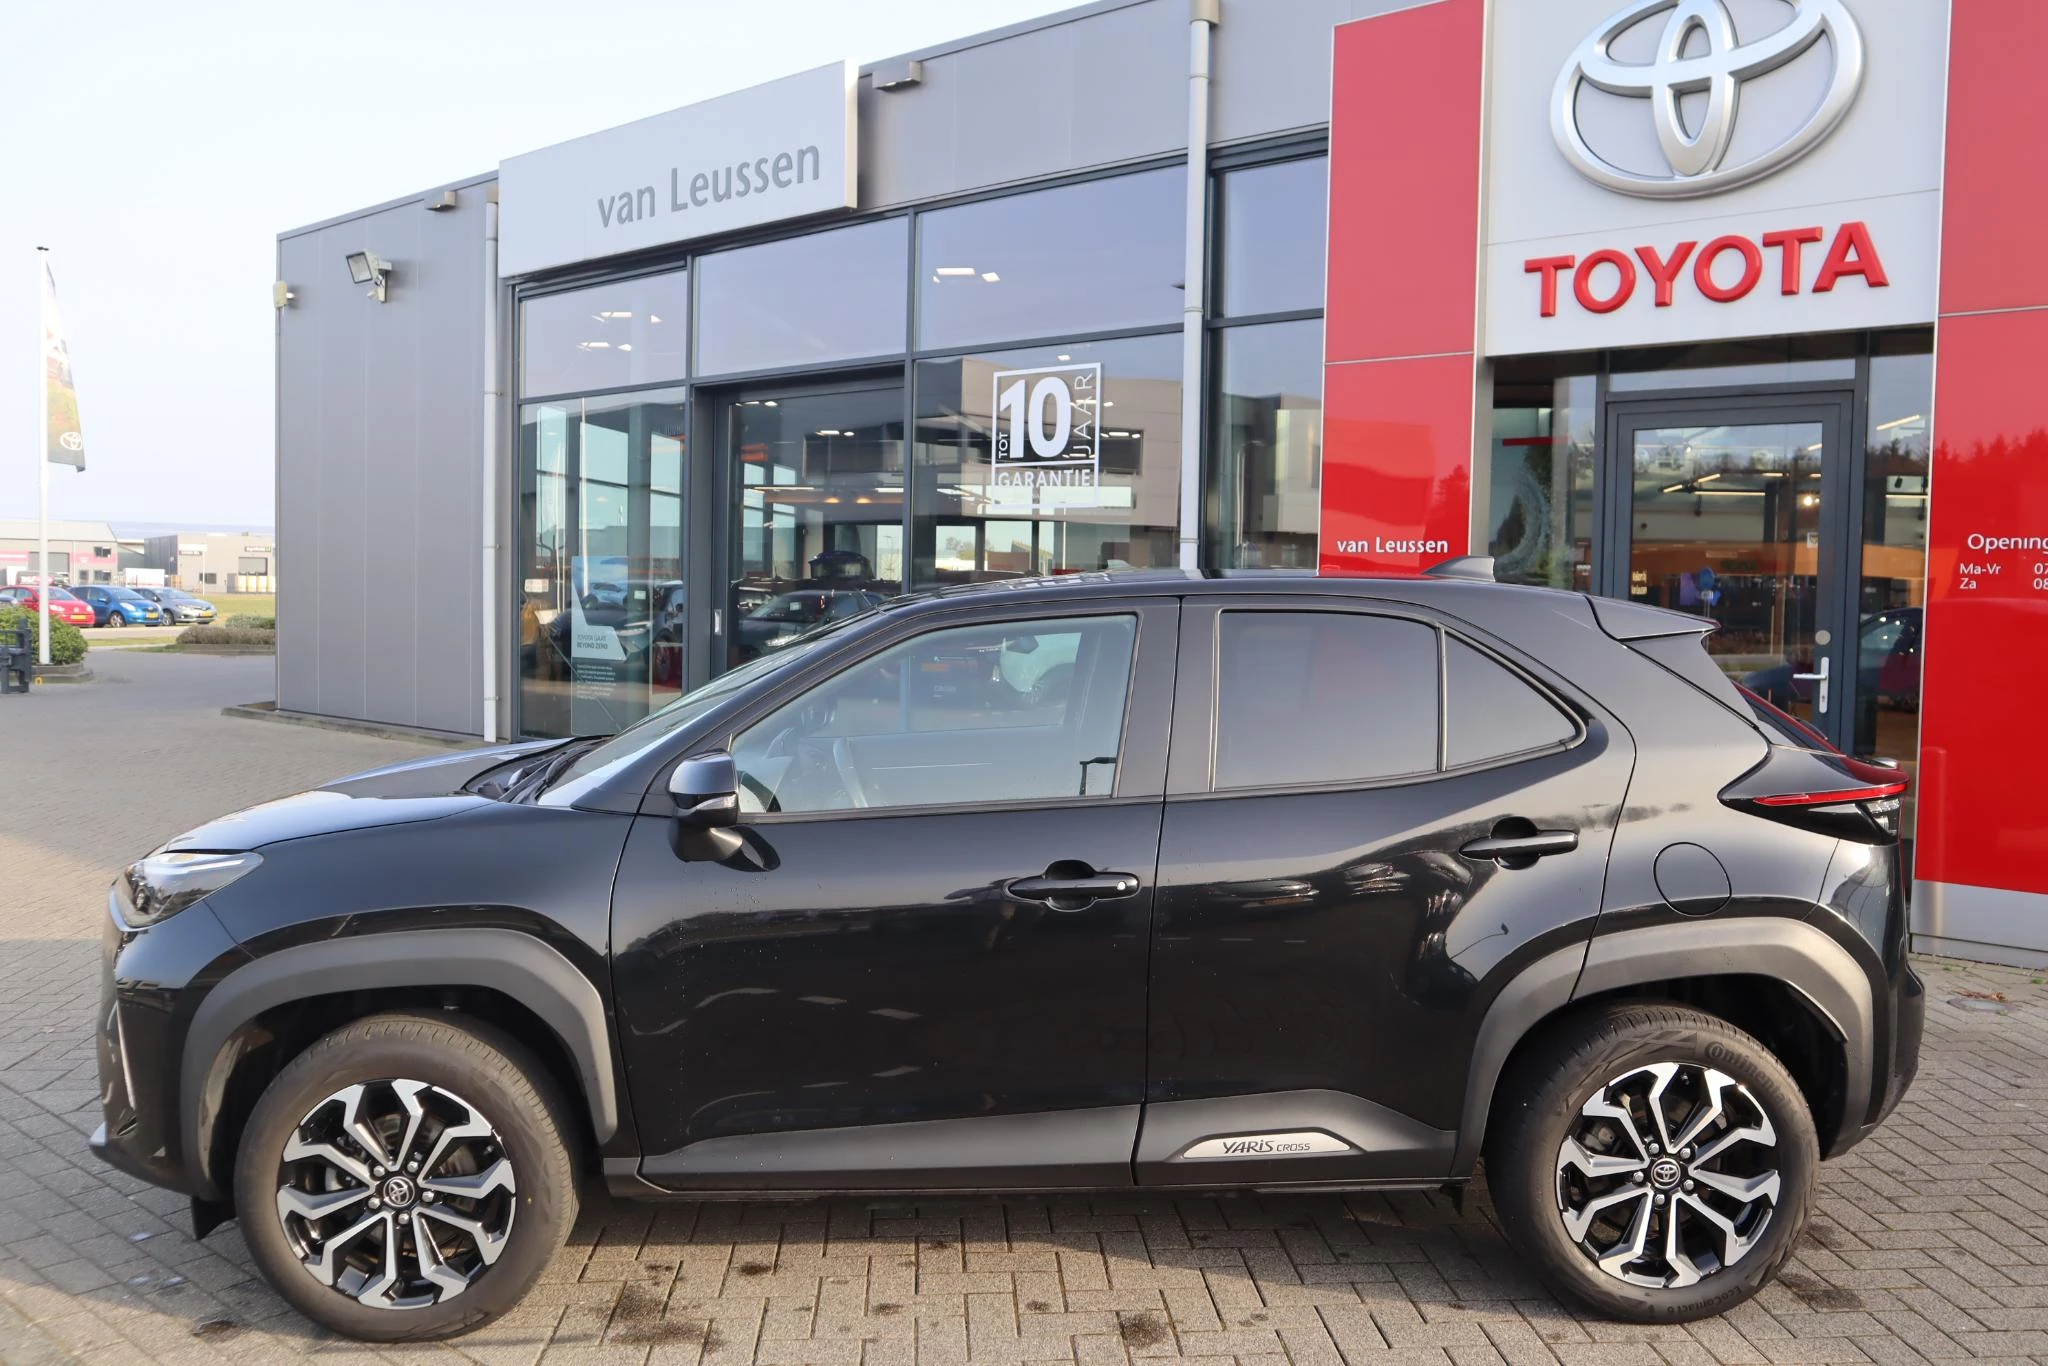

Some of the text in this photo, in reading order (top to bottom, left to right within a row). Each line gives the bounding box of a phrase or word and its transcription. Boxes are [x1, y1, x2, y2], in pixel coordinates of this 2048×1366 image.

[597, 144, 820, 228] van Leussen
[1524, 221, 1890, 318] TOYOTA
[999, 376, 1072, 458] 10
[1073, 372, 1094, 455] JAAR
[998, 432, 1008, 459] TOT
[998, 469, 1091, 488] GARANTIE
[1336, 536, 1449, 553] van Leussen
[1960, 562, 2001, 575] Ma-Vr
[1960, 577, 1977, 589] Za
[1276, 1142, 1311, 1152] CROSS
